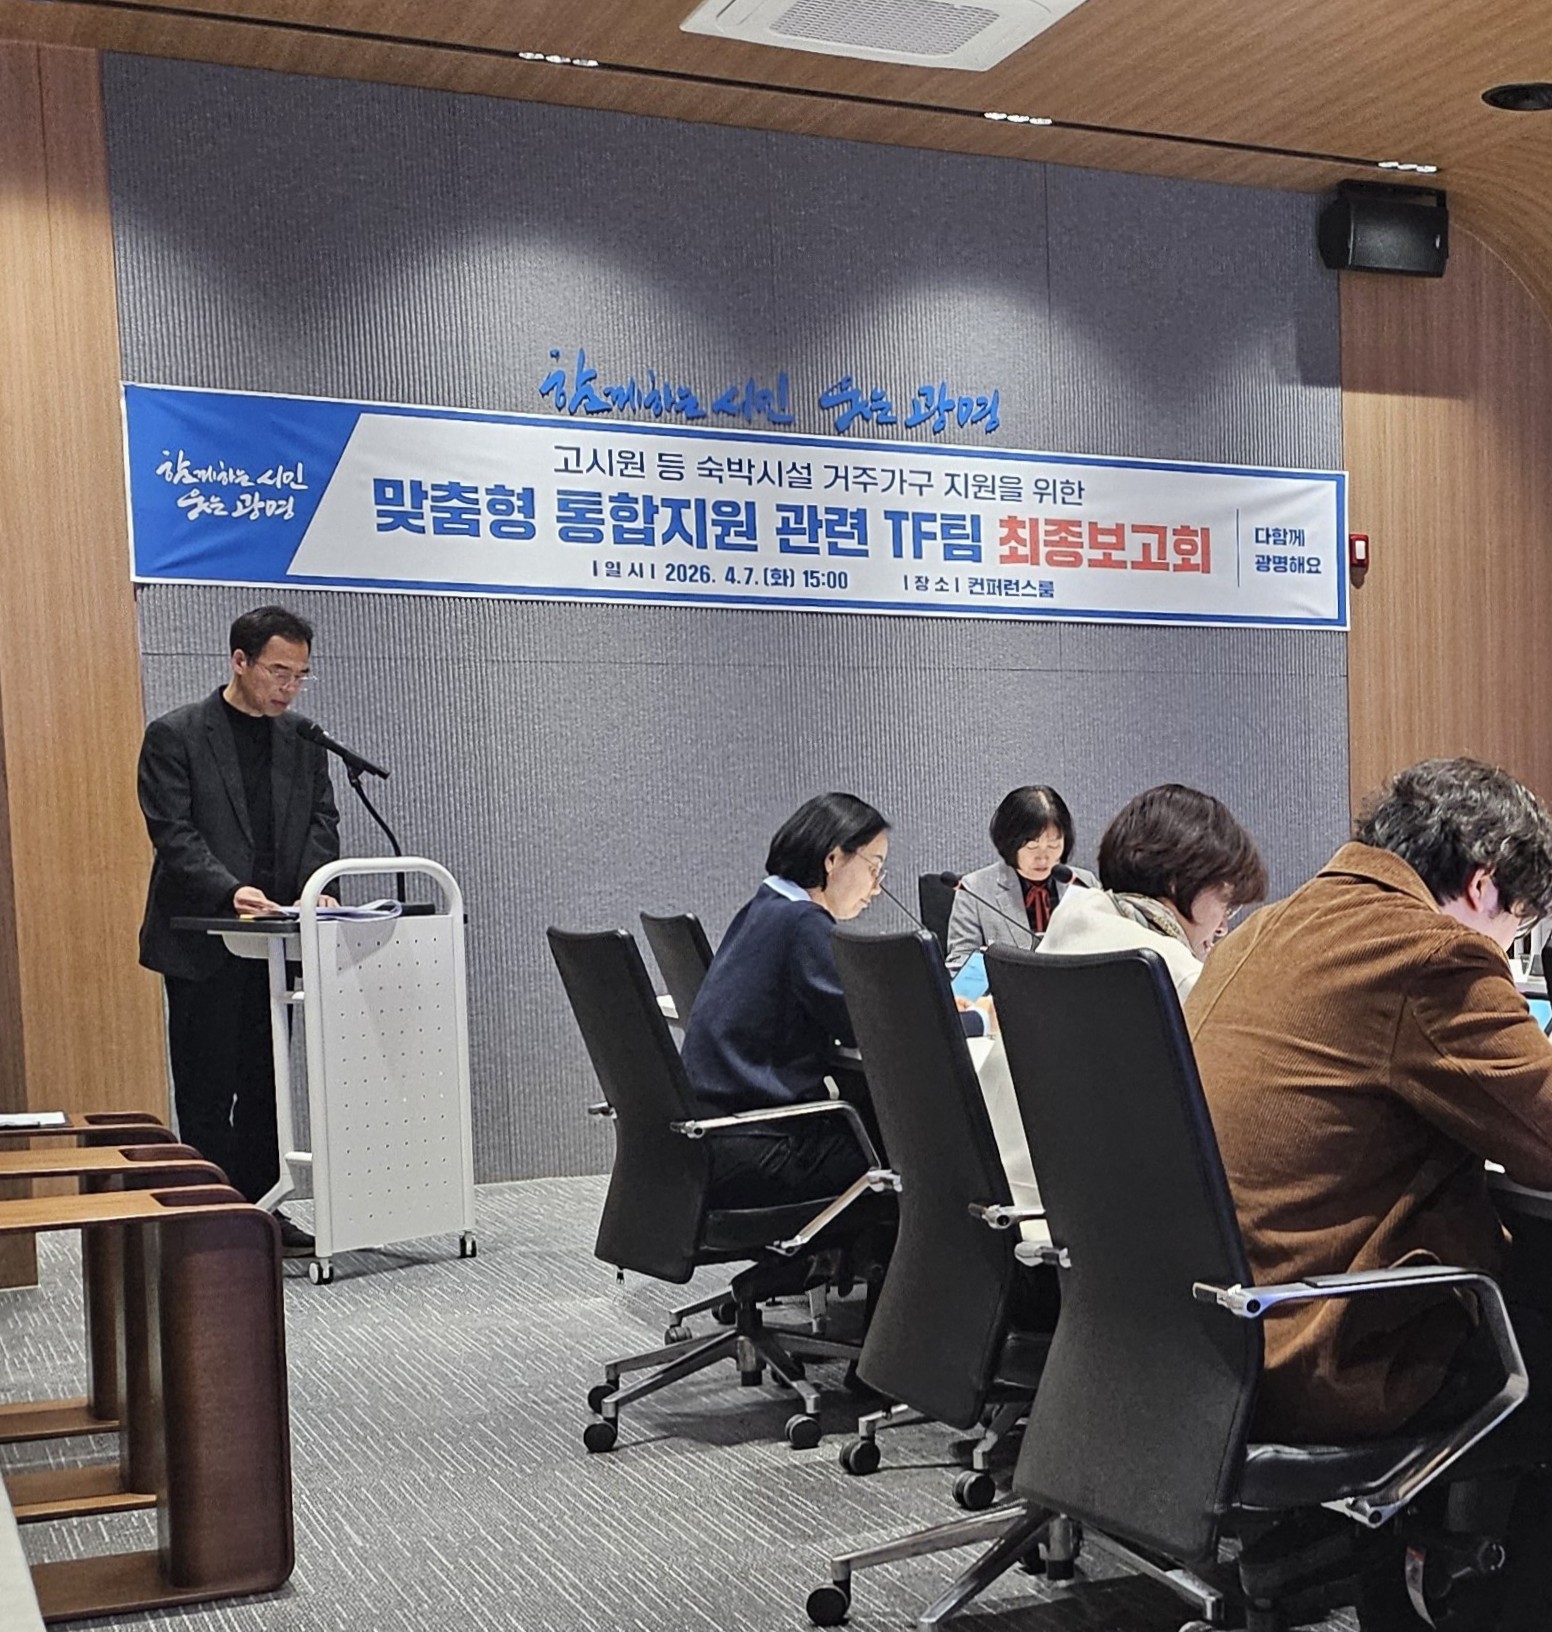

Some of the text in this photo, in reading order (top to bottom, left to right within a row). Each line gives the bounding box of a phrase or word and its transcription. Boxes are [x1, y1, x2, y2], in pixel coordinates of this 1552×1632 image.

[712, 372, 794, 425] 시민
[905, 381, 1000, 435] 광명
[257, 462, 308, 490] 시민
[554, 445, 1085, 507] 고시원 등 숙박시설 거주가구 지원을 위한
[231, 491, 295, 521] 광명
[373, 478, 1211, 574] 맞춤형 통합지원 관련 TF팀 최종보고회
[1254, 526, 1305, 547] 다함께
[1254, 553, 1322, 575] 광명해요
[665, 563, 716, 584] 2026.
[802, 569, 848, 589] 15:00
[967, 576, 1055, 599] 컨퍼런스룸
